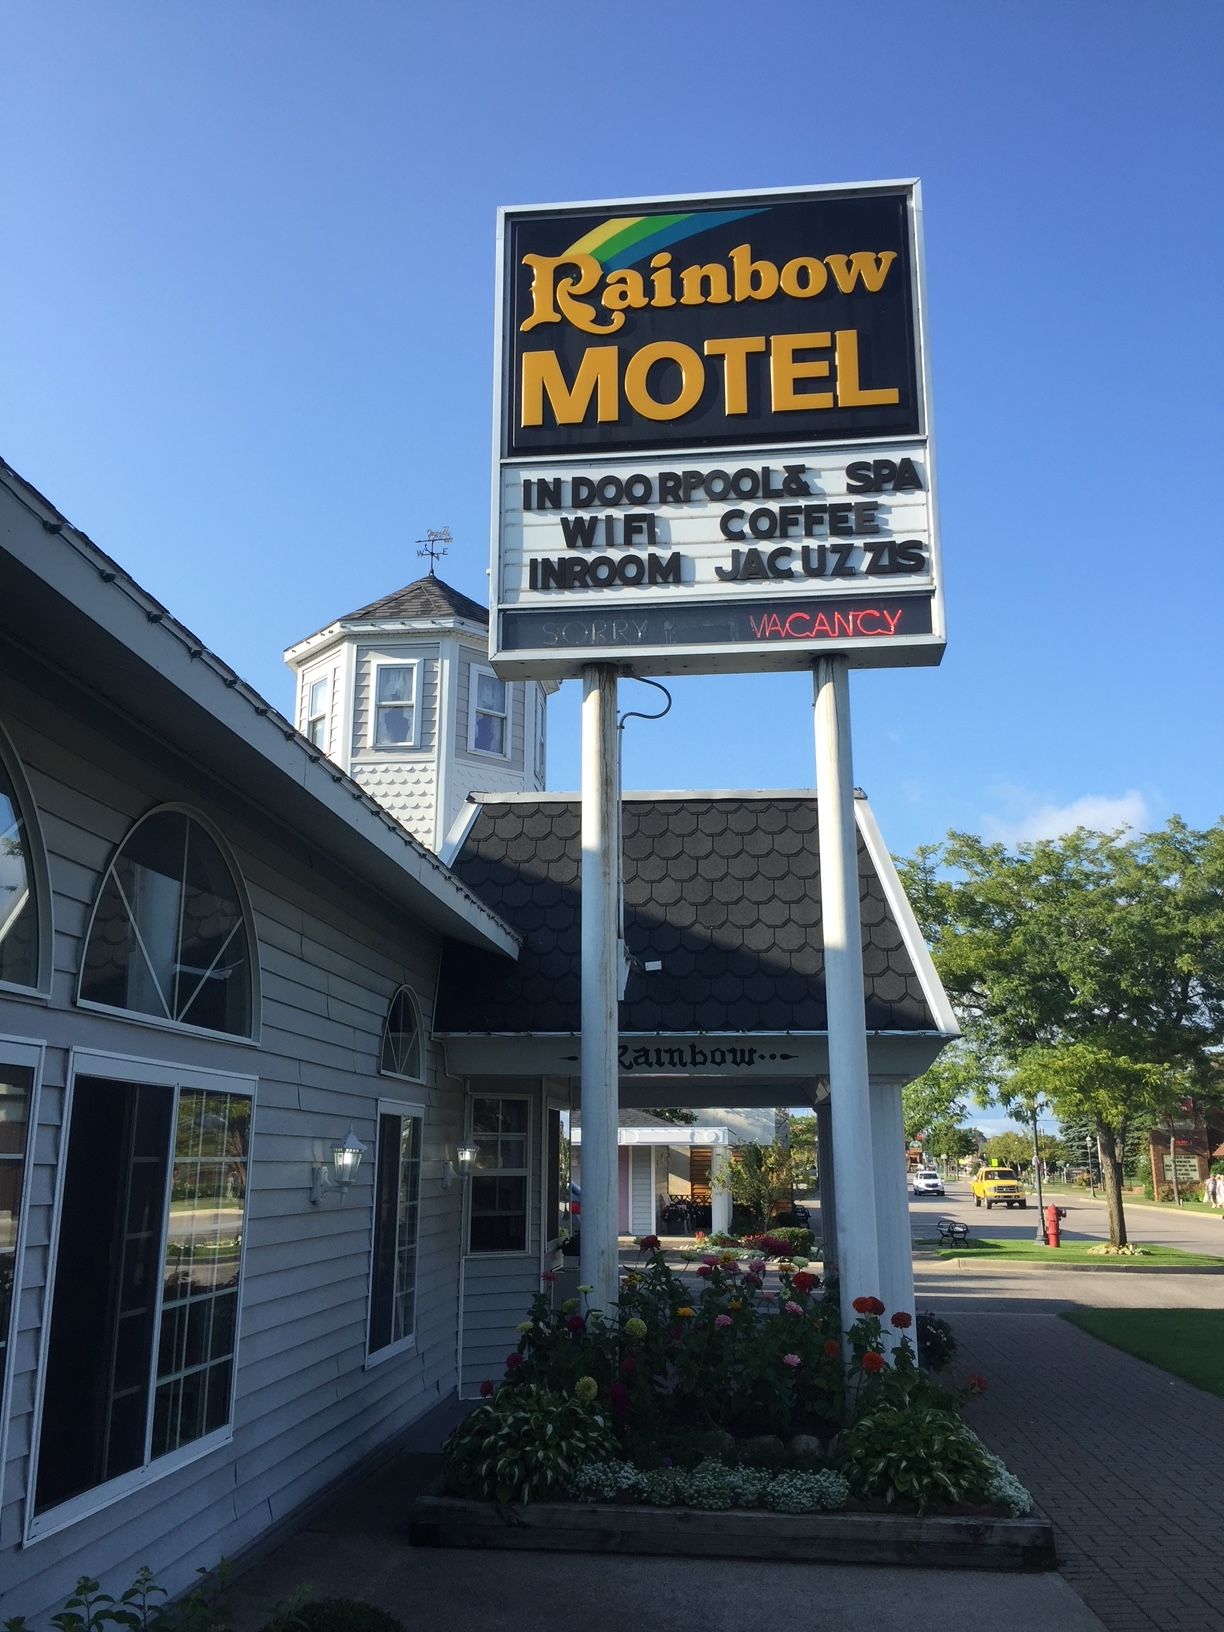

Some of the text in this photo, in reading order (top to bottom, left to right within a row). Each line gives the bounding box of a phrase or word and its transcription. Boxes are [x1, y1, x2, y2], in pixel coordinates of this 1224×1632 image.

[520, 243, 898, 335] Rainbow
[521, 329, 900, 428] MOTEL
[845, 457, 923, 493] SPA
[560, 501, 880, 548] WIFI COFFEE
[714, 540, 926, 581] JACUZZIS
[542, 618, 648, 646] SORRY
[750, 609, 903, 639] VACANCY
